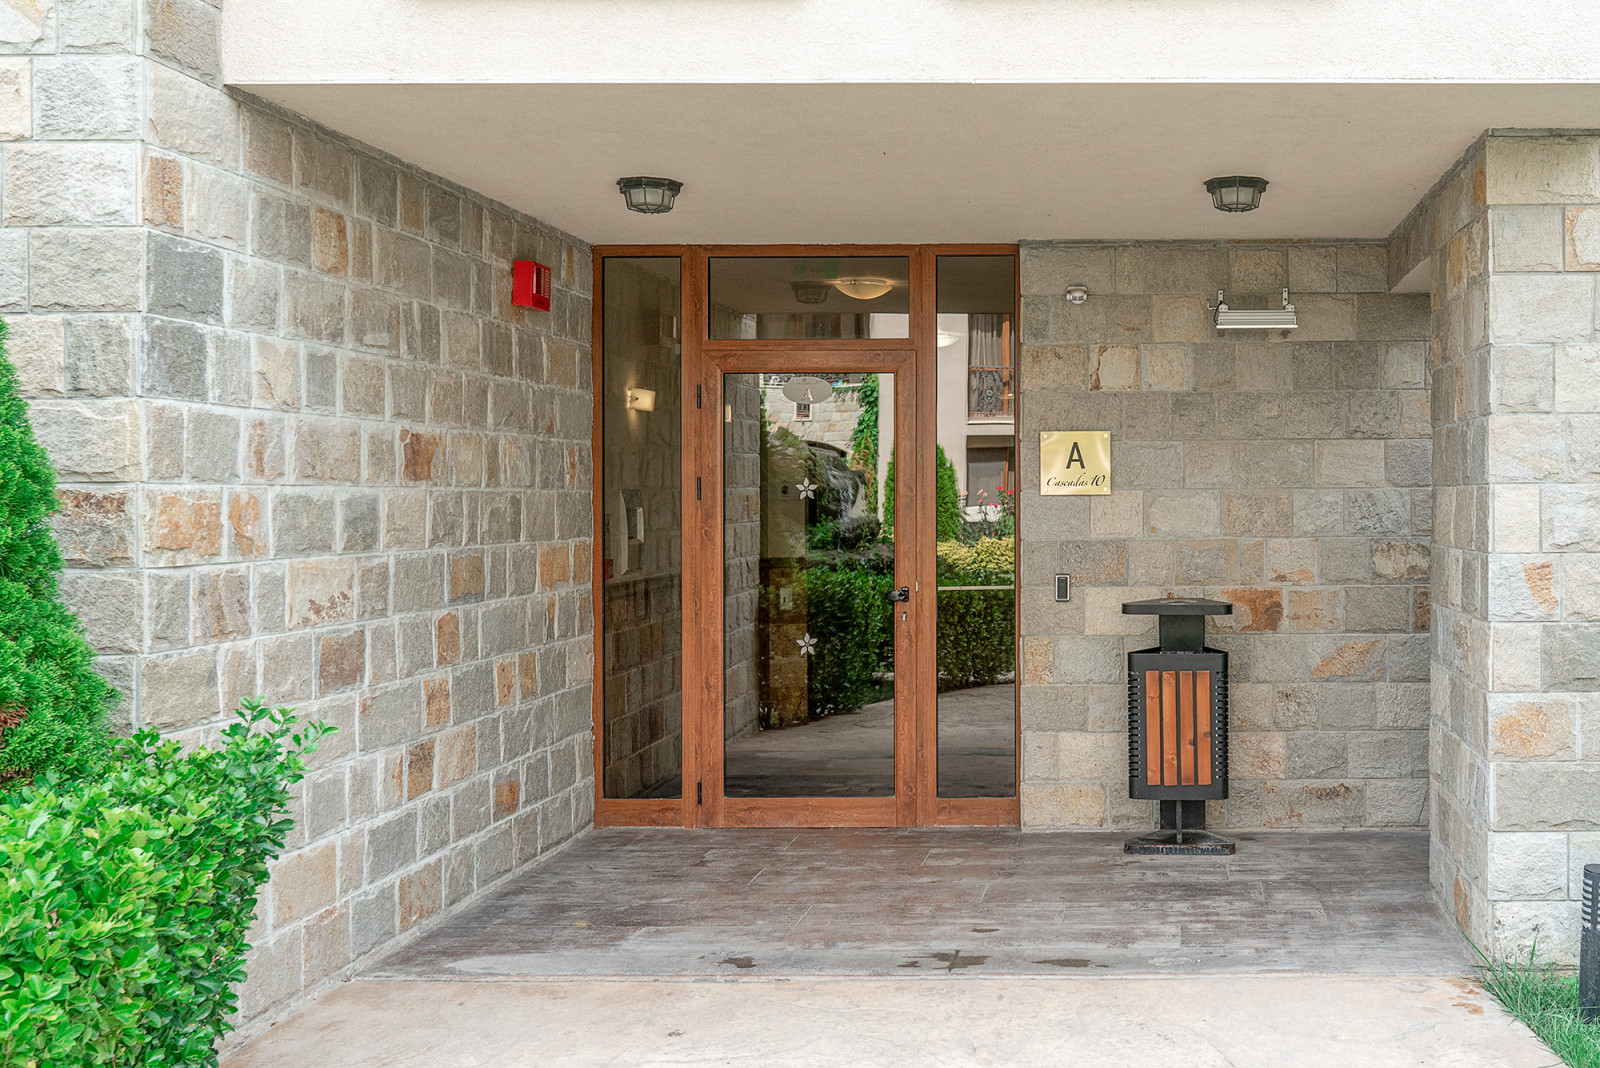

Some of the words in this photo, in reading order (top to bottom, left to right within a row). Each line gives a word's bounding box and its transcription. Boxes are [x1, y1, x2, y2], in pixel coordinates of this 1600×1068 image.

[1065, 441, 1086, 470] A
[1046, 472, 1089, 487] Cascadas
[1090, 474, 1106, 487] 10
